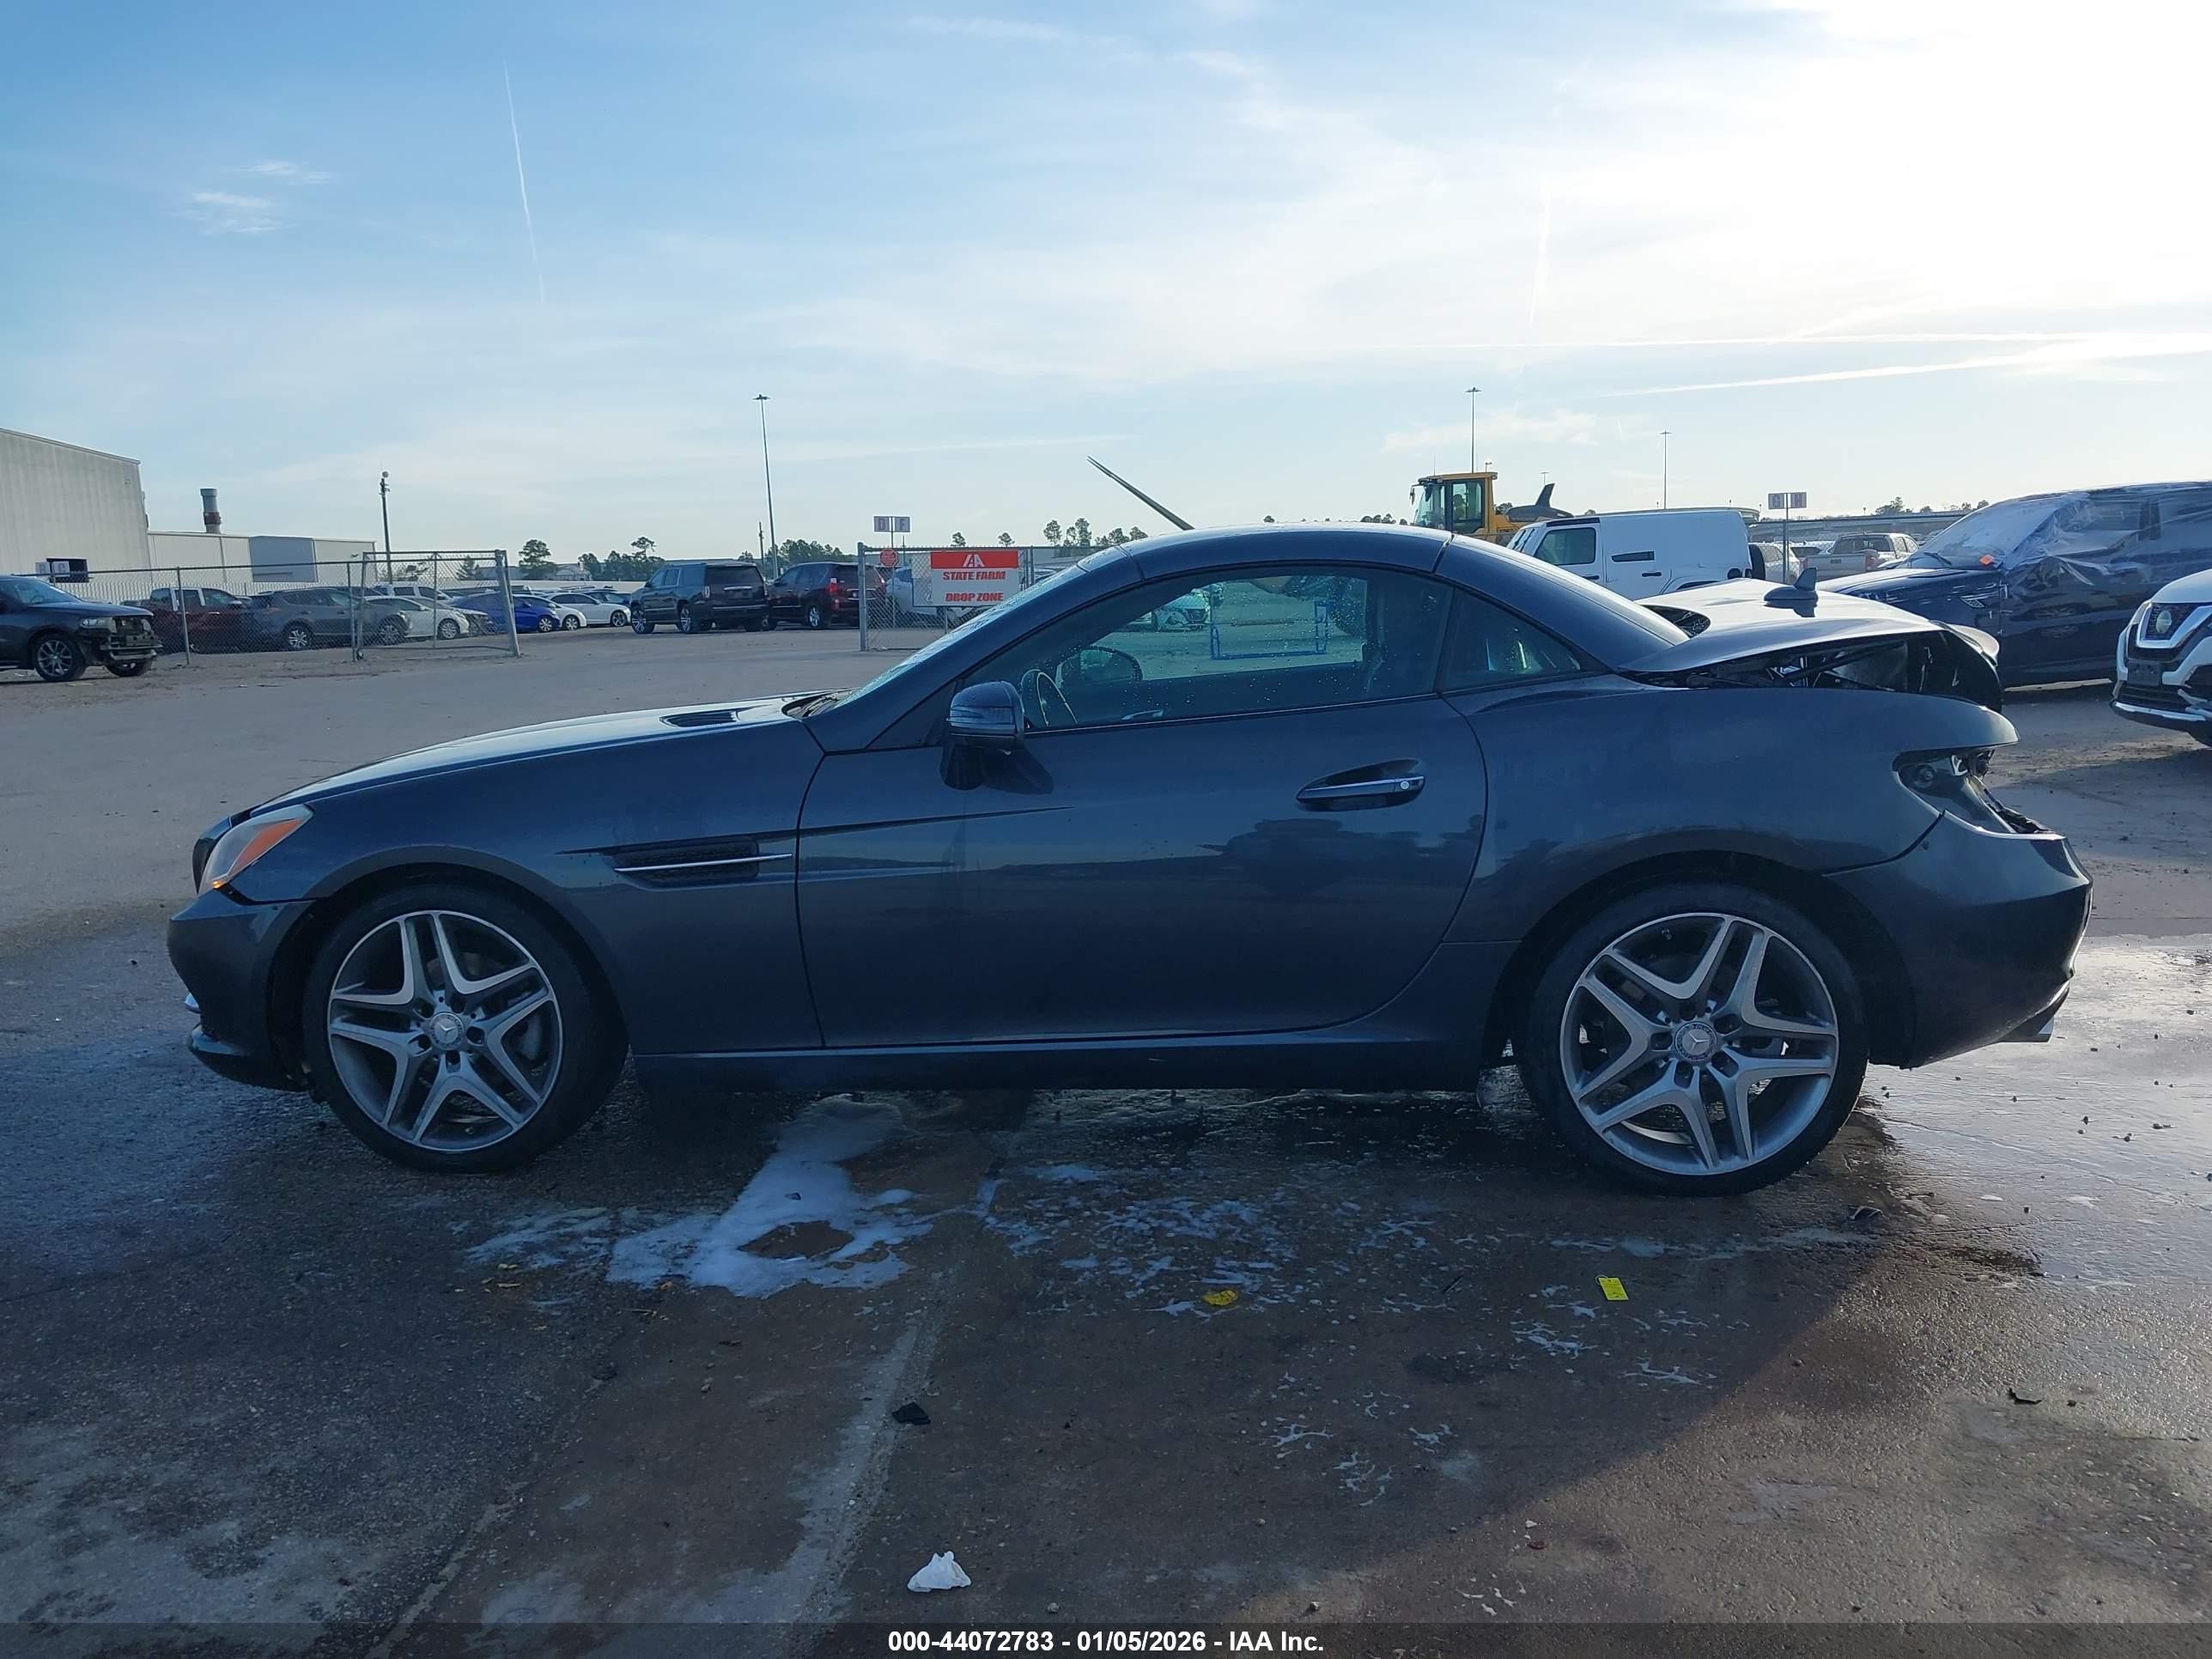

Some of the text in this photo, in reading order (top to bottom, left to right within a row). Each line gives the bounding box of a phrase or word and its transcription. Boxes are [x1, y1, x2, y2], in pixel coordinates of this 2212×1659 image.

[943, 571, 1006, 580] STATE FARM
[945, 592, 1004, 602] DROP ZONE
